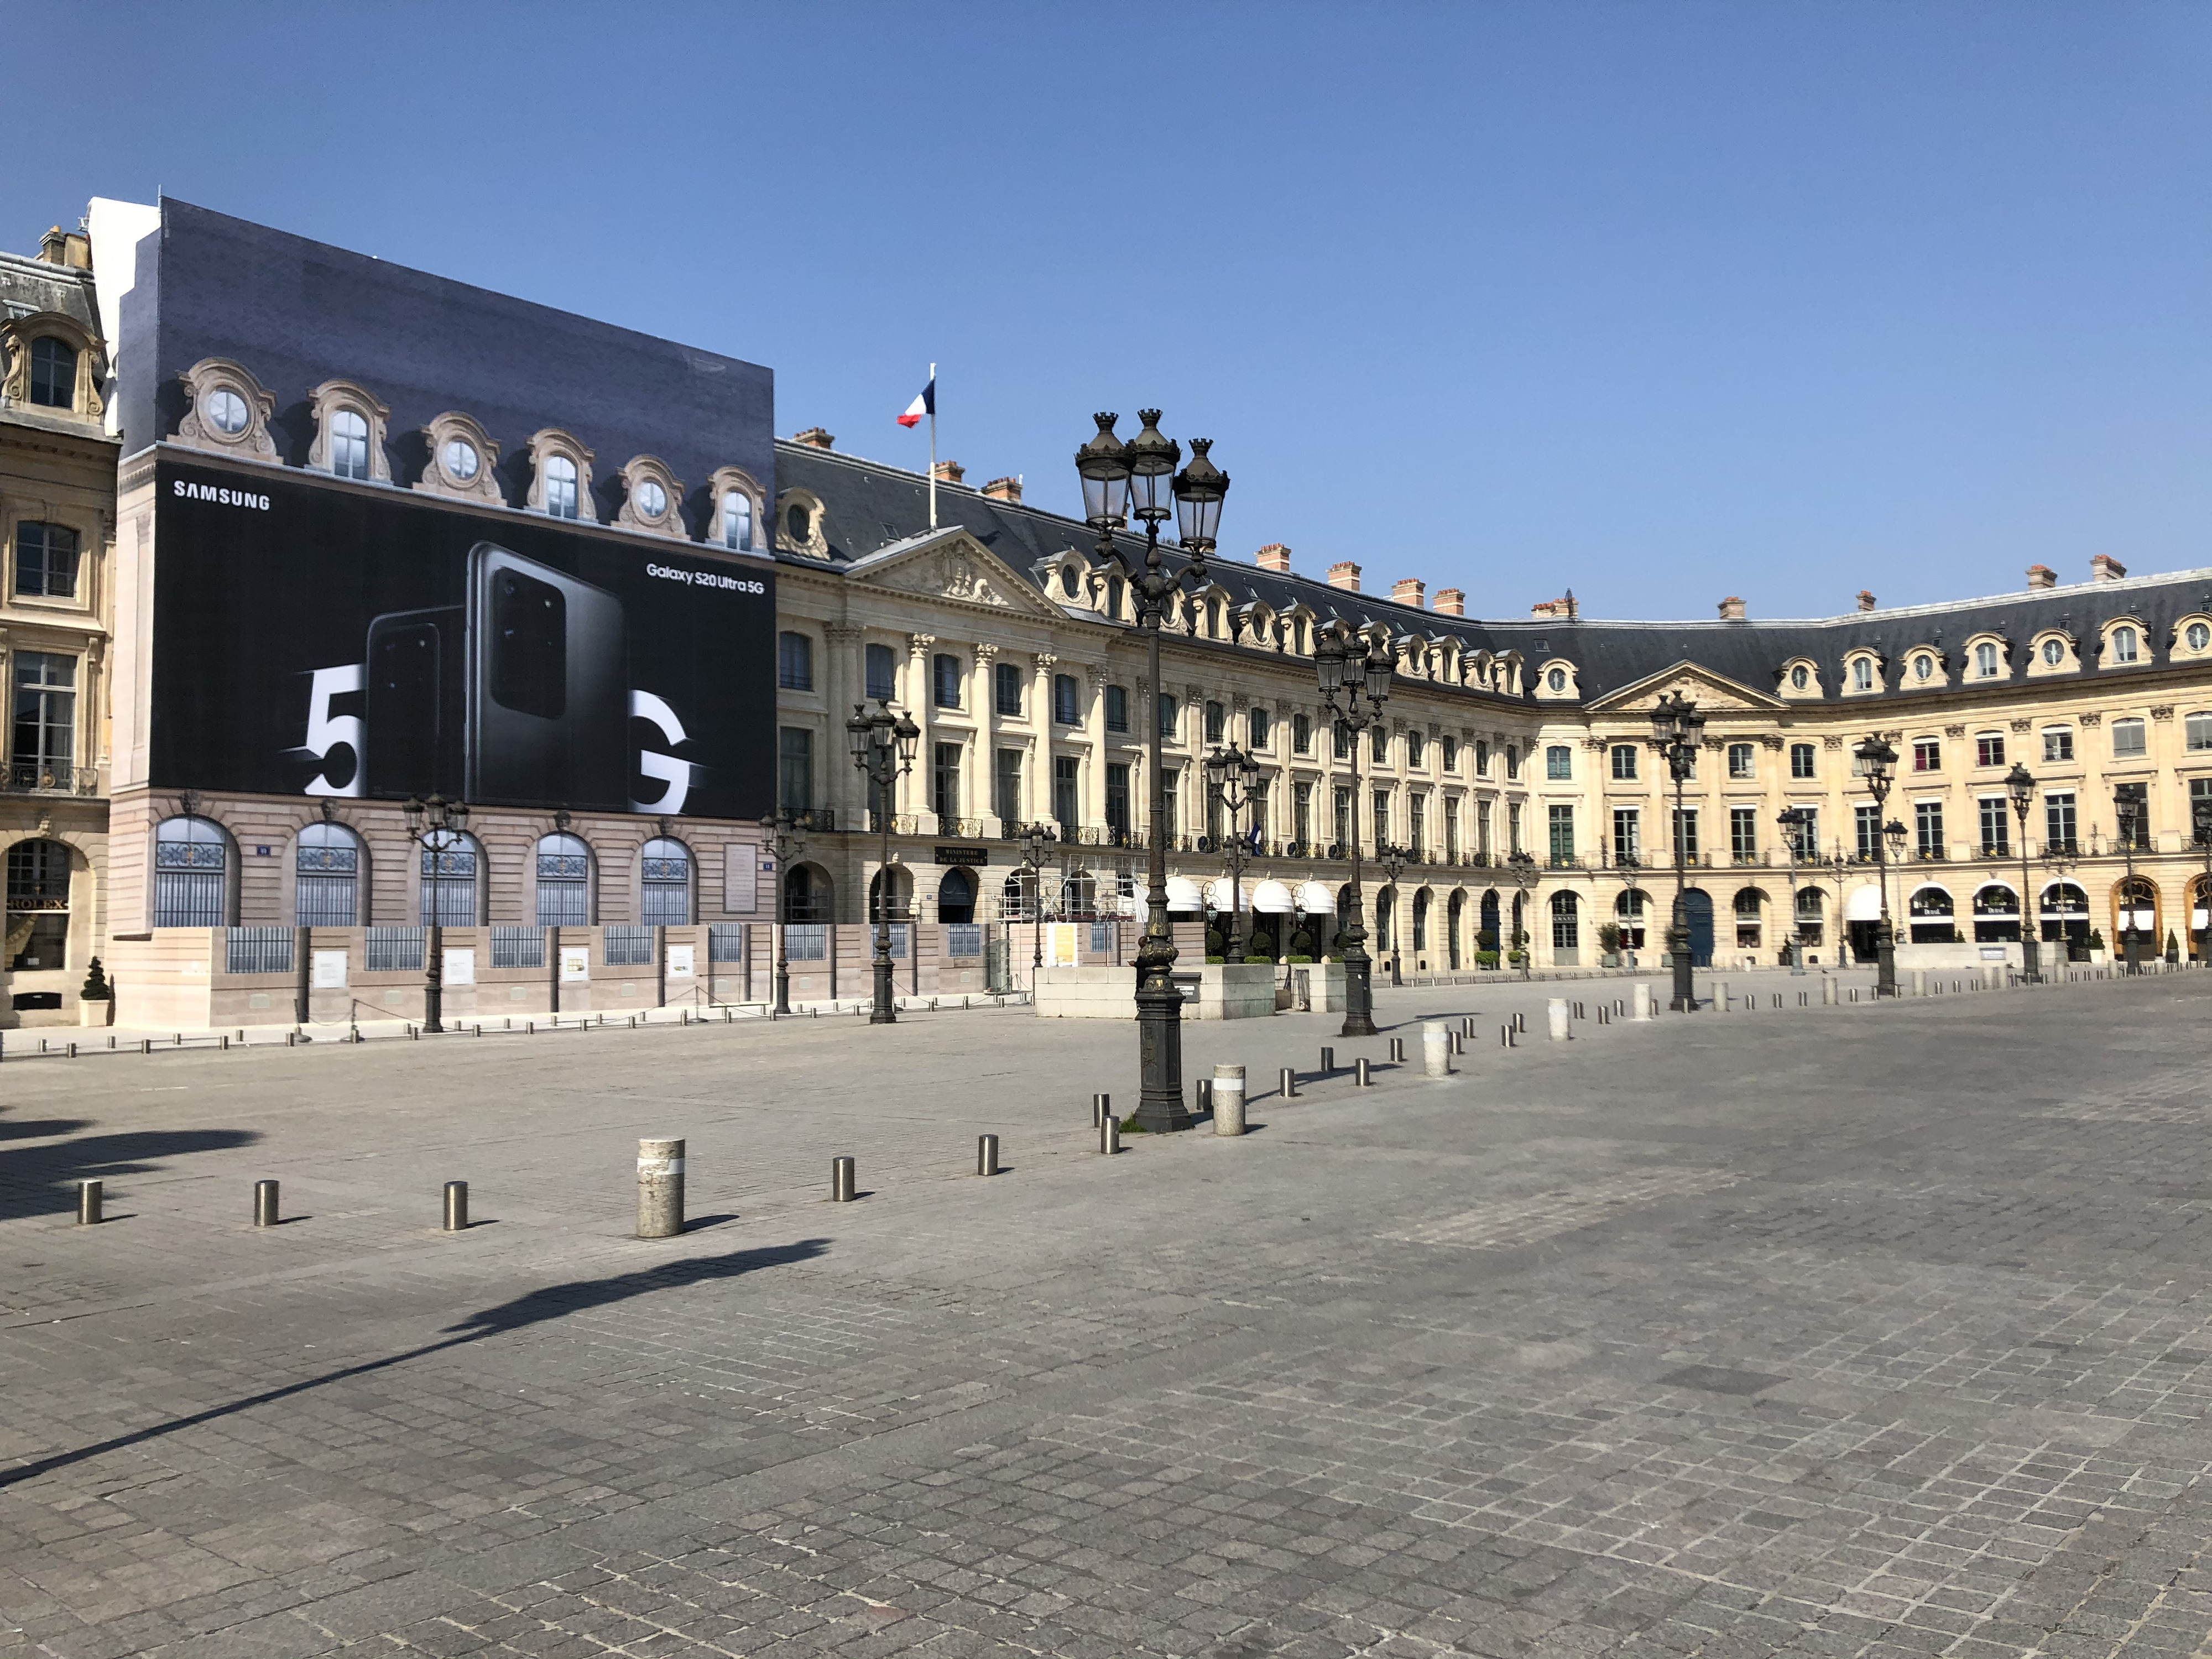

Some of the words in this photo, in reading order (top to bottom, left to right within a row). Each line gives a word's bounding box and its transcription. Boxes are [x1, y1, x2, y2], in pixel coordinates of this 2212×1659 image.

[174, 480, 270, 511] SAMSUNG
[646, 563, 693, 586] Galaxy
[695, 572, 717, 587] S20
[717, 576, 746, 592] Ultra
[747, 581, 765, 594] 5G
[9, 899, 63, 909] ROLEX
